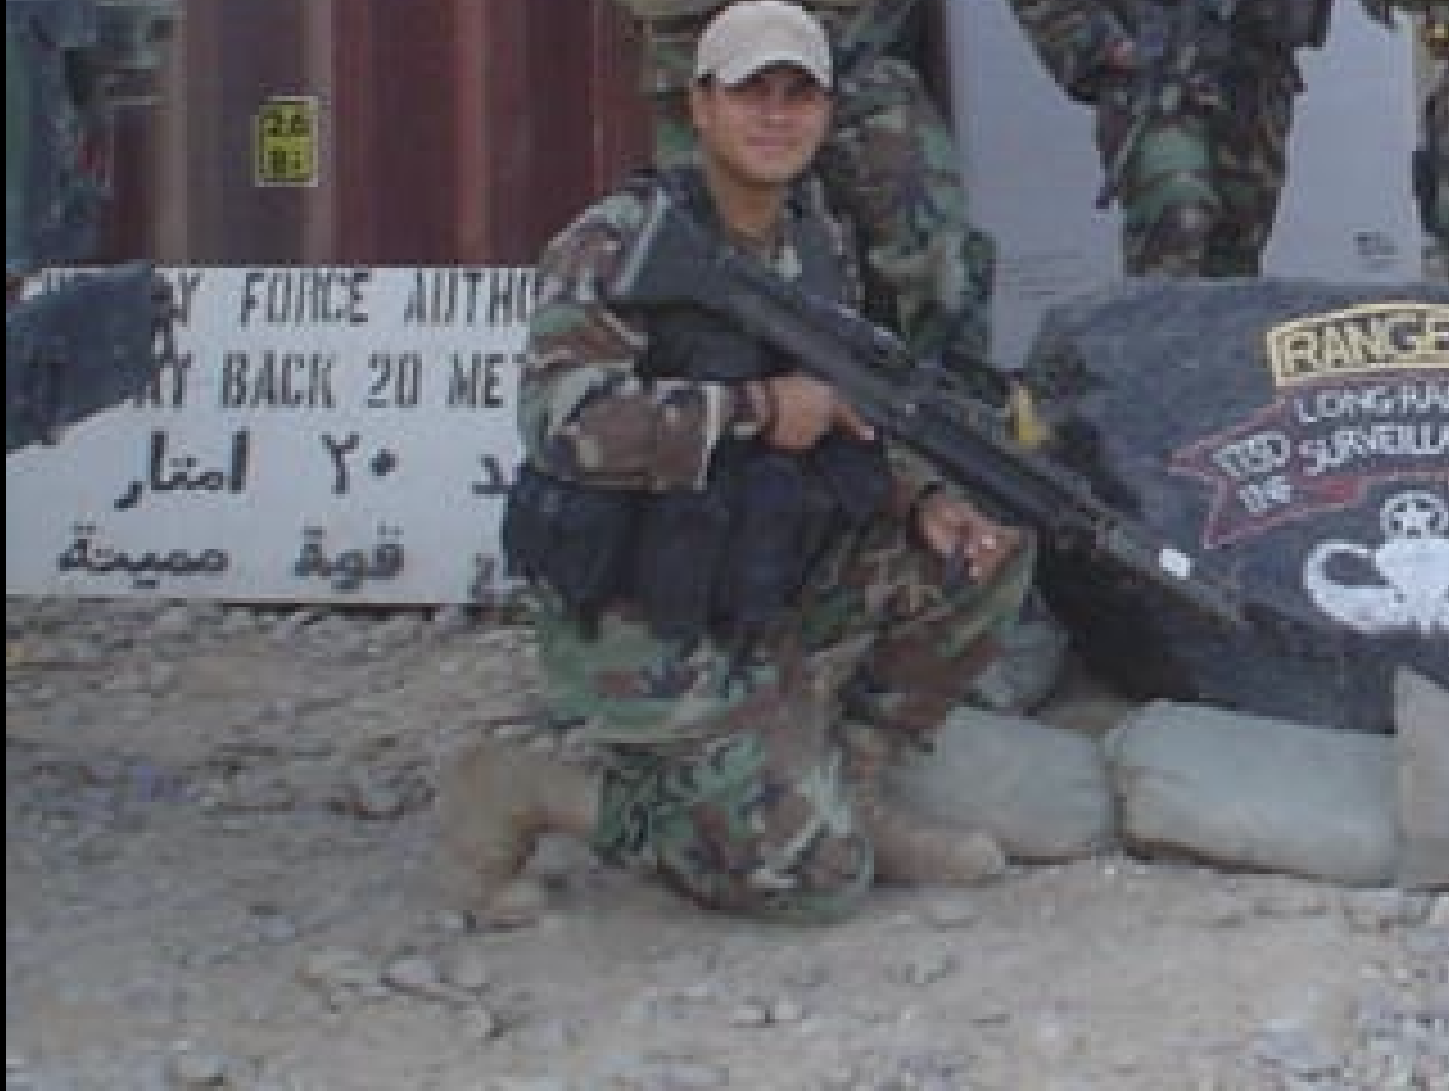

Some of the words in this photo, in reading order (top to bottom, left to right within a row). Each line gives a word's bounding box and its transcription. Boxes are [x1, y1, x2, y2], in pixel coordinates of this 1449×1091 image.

[240, 271, 371, 327] FORCE
[222, 352, 337, 409] BACK
[366, 352, 423, 409] 20
[1294, 388, 1398, 423] LONG
